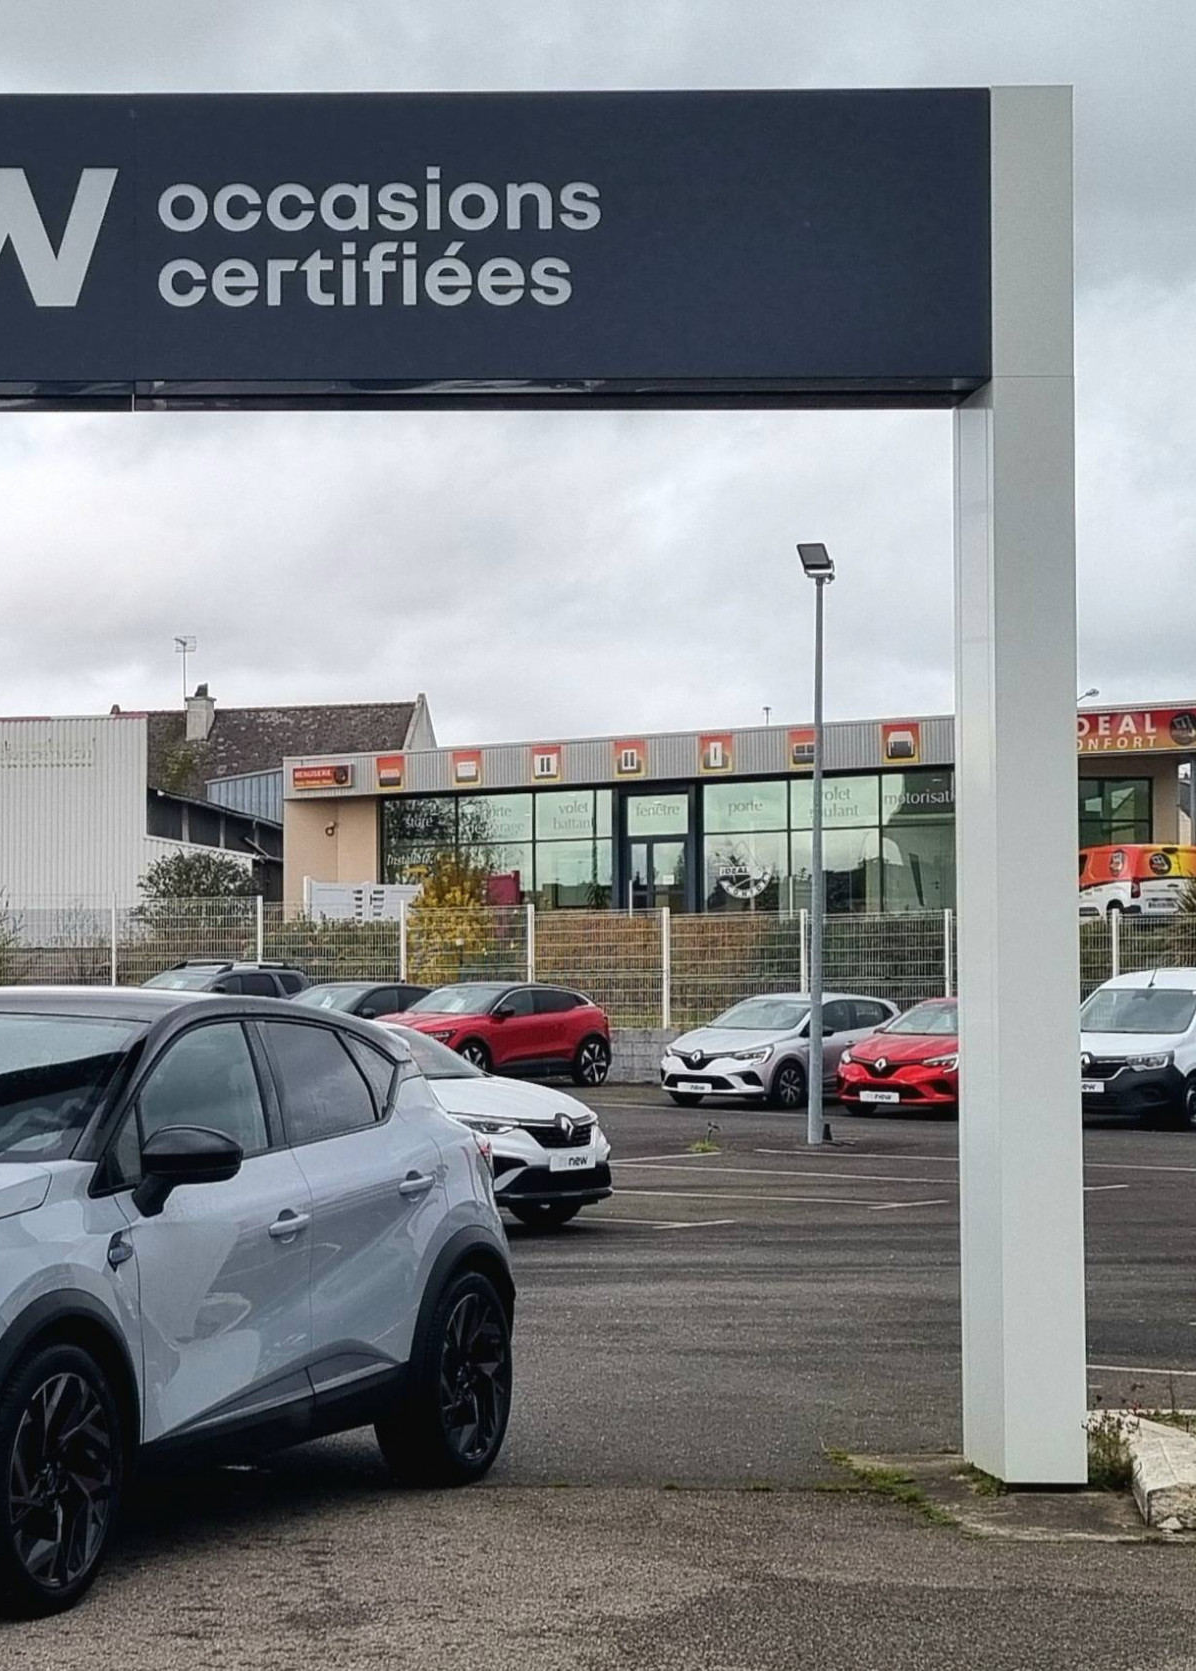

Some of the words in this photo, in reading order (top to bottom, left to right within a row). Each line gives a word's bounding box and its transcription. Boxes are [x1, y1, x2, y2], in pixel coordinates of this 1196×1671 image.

[157, 165, 602, 232] occasions
[157, 241, 573, 307] certifiées
[1077, 714, 1157, 737] DEAL
[824, 786, 851, 801] olet
[559, 801, 588, 814] volet
[636, 802, 680, 817] fenêtre
[729, 800, 763, 816] porte
